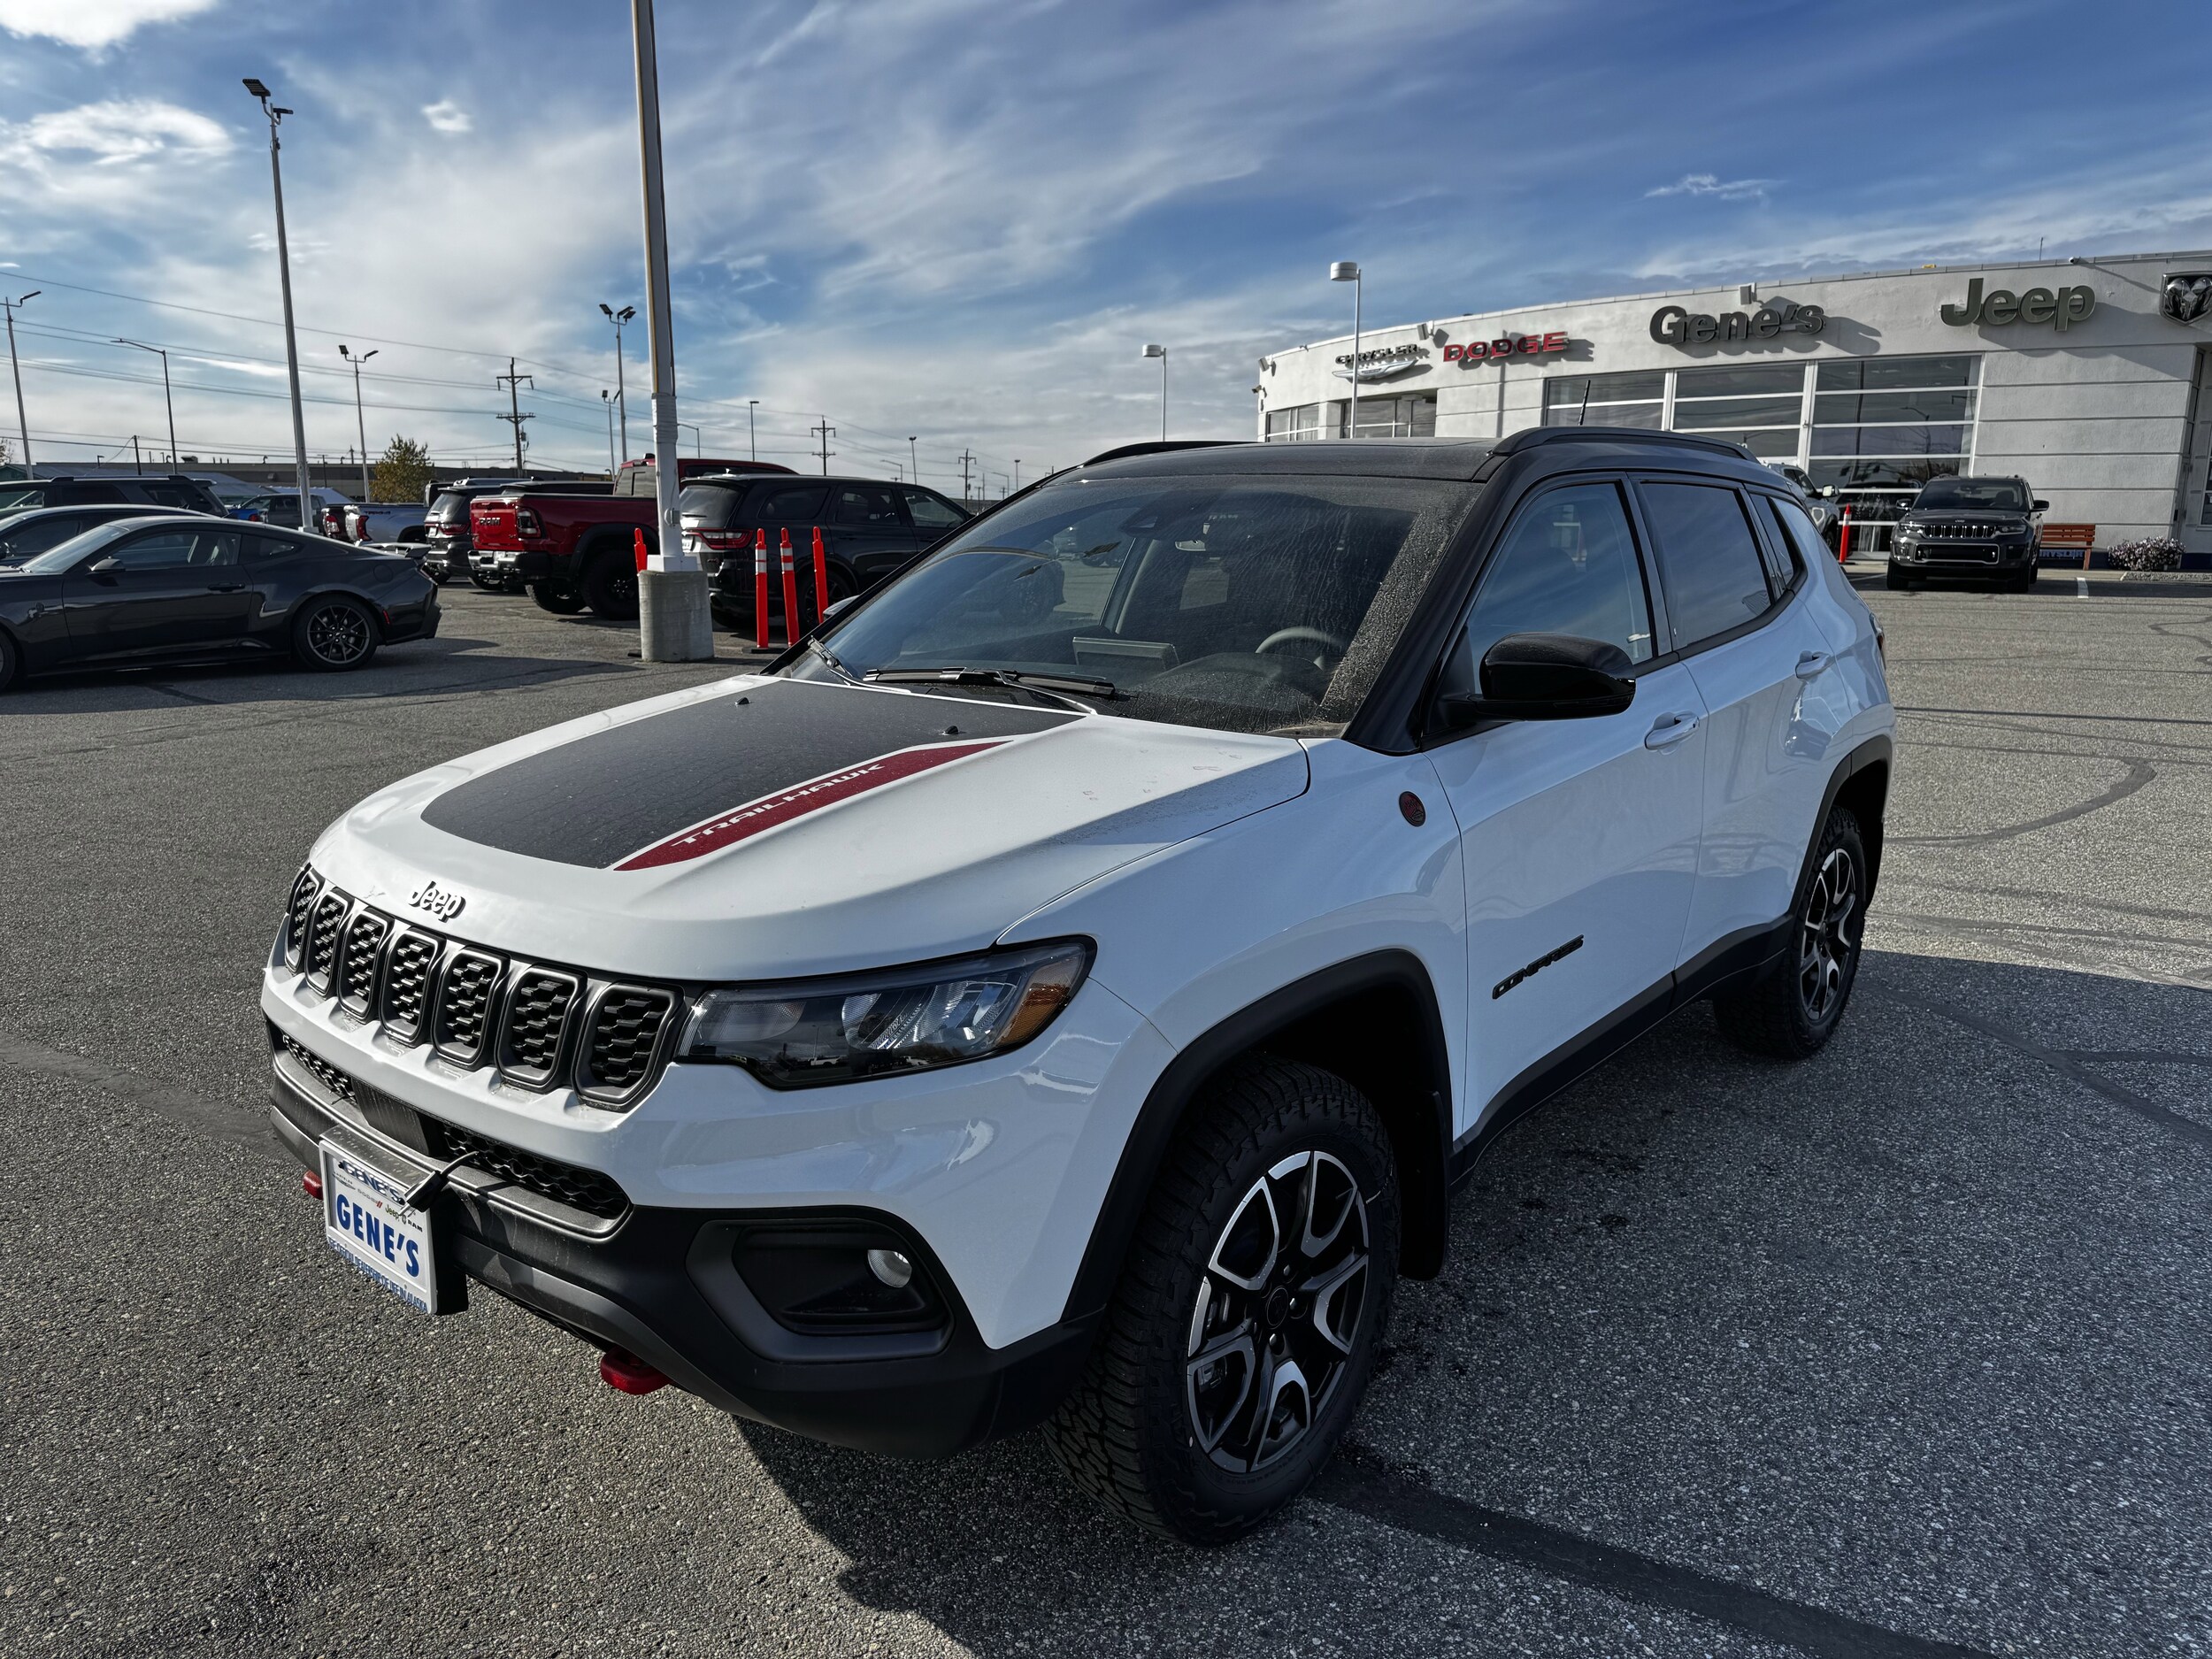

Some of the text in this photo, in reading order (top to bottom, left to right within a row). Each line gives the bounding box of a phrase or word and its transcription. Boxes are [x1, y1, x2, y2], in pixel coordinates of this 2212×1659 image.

[1649, 304, 1824, 345] Gene's
[1940, 278, 2095, 331] Jeep
[1335, 343, 1417, 364] CHRYSLER
[1443, 331, 1569, 362] DODGE
[2039, 549, 2084, 557] RYSLER
[671, 764, 886, 847] TRAILHAWK
[407, 879, 466, 923] Jeep
[1492, 934, 1584, 1000] COMPASS
[336, 1194, 420, 1278] GENE'S
[407, 1219, 423, 1233] RAM
